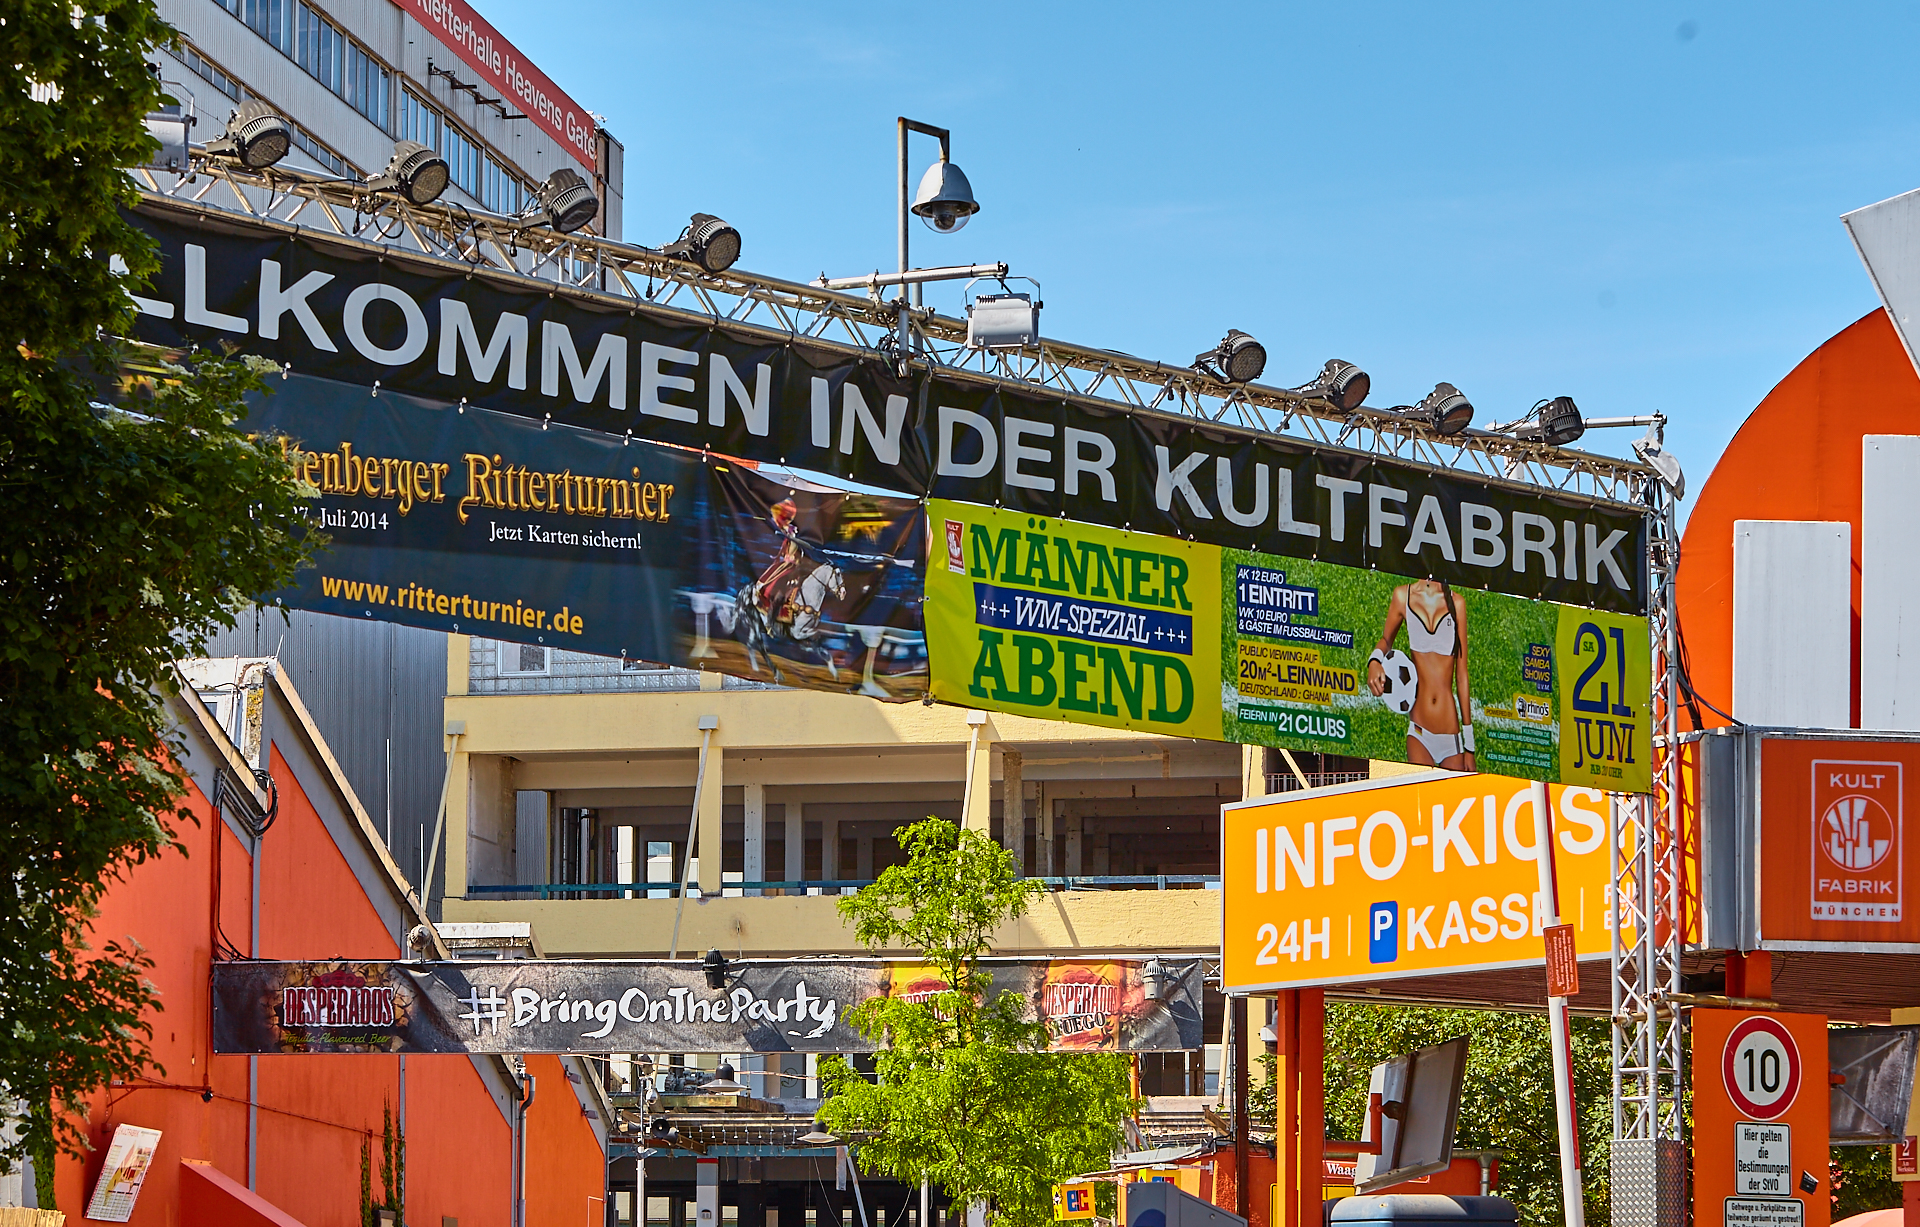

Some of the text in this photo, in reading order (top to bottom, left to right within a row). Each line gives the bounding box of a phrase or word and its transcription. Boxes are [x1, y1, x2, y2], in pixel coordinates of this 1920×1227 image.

[505, 54, 563, 132] Heavens
[566, 111, 595, 159] Gate
[109, 243, 1630, 591] LLKOMMEN IN DER KULTFABRIK
[457, 453, 675, 524] Ritterturnier
[319, 507, 347, 530] Juli
[350, 510, 389, 530] 2014
[489, 521, 642, 550] Jetzt Karten sichern!
[970, 517, 1193, 612] MÄNNER
[1237, 568, 1284, 585] AK 12 EURO
[322, 576, 583, 635] www.ritterturnier.de
[1239, 583, 1315, 612] 1 EINTRITT
[1015, 596, 1150, 644] WM-SPEZIAL
[1256, 609, 1265, 620] 10
[1265, 612, 1288, 623] EURO
[1238, 619, 1352, 645] & GÄSTE IM FUSSBALL-TRIKOT
[1240, 644, 1318, 663] PUBLIC VIEWING AUF
[1532, 645, 1550, 657] SEXY
[1525, 656, 1550, 669] SAMBA
[1573, 622, 1635, 718] 21.
[968, 628, 1194, 724] ABEND
[1524, 668, 1550, 682] SHOWS
[1240, 682, 1297, 697] DEUTSCHLAND
[1303, 690, 1330, 702] GHANA
[1239, 708, 1346, 739] FEIERN IN 21 CLUBS
[1573, 717, 1635, 768] JUNI
[1590, 764, 1601, 775] AB
[1608, 766, 1623, 778] UHR
[1830, 773, 1886, 789] KULT
[1818, 879, 1893, 894] FABRIK
[1813, 904, 1899, 917] MÜNCHEN
[1256, 917, 1330, 965] 24H
[284, 987, 394, 1026] DESPERADOS
[1043, 984, 1118, 1016] DESPERADOS
[368, 1033, 391, 1044] Beer
[1743, 1048, 1780, 1093] 10
[1744, 1128, 1782, 1145] Hier gelten
[1757, 1146, 1769, 1159] die
[1902, 1139, 1910, 1157] 2
[1738, 1160, 1789, 1177] Bestimmungen
[1748, 1178, 1779, 1191] der StVO
[1728, 1213, 1749, 1221] teilweise
[1731, 1203, 1754, 1213] Gehwege
[1760, 1203, 1786, 1213] Parkplätze
